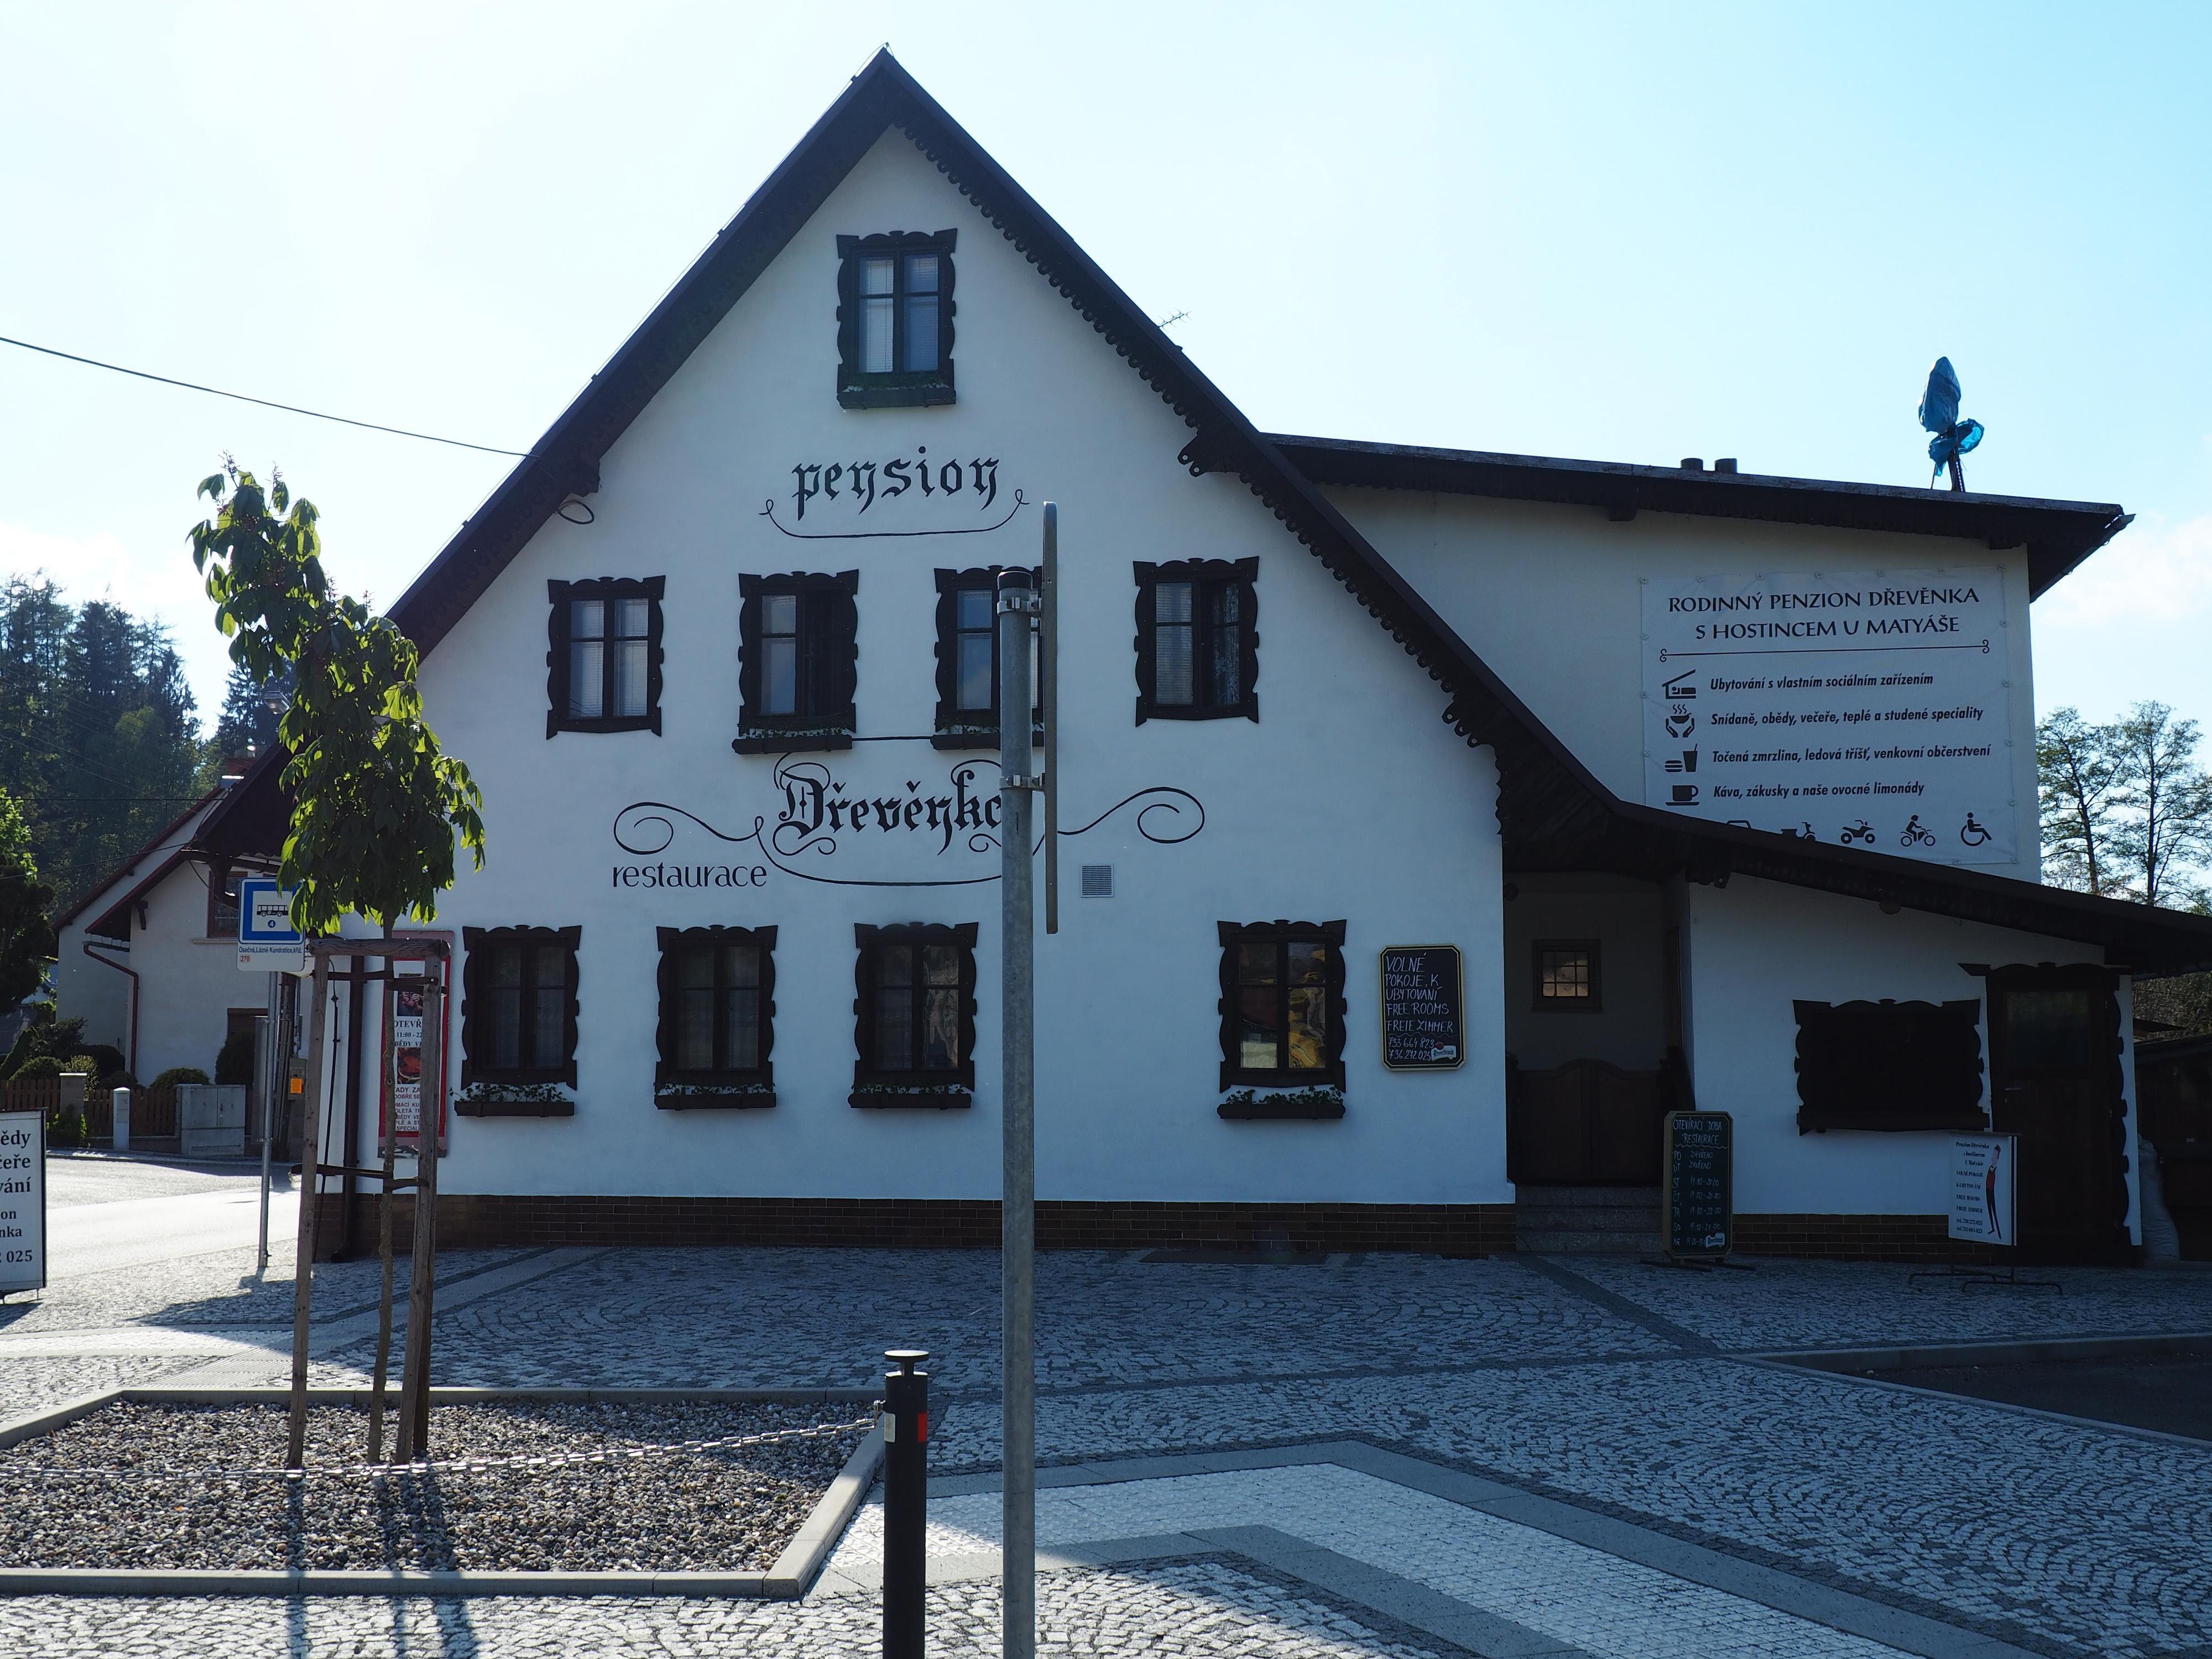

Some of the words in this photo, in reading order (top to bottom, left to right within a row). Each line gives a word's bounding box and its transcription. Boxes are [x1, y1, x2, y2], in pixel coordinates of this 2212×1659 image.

[791, 446, 1000, 521] pension
[1669, 592, 1763, 612] RODINNÝ
[1770, 592, 1860, 609] PENZION
[1869, 587, 1979, 606] DŘEVĚNKA
[1696, 624, 1705, 639] S
[1713, 620, 1837, 639] HOSTINCEM
[1844, 620, 1859, 635] U
[1867, 614, 1959, 634] MATYÁŠE
[1710, 677, 1766, 692] Ubytování
[1777, 676, 1822, 688] vlastním
[1826, 674, 1876, 686] sociálním
[1880, 673, 1933, 686] zařízením
[1711, 712, 1758, 726] Snídaně,
[1762, 712, 1797, 726] obědy,
[1801, 711, 1839, 724] večeře,
[1843, 709, 1871, 724] teplé
[1875, 712, 1881, 721] a
[1885, 708, 1928, 721] studené
[1932, 706, 1983, 722] speciality
[1713, 750, 1749, 763] Točená
[1752, 749, 1802, 763] zmrzlina,
[1805, 748, 1841, 760] ledová
[1845, 747, 1871, 761] tříšť,
[1874, 745, 1925, 759] venkovní
[1927, 744, 1991, 757] občerstvení
[1713, 785, 1743, 800] Káva,
[1746, 784, 1790, 799] zákusky
[1792, 787, 1799, 796] a
[1803, 784, 1828, 795] naše
[1832, 782, 1870, 795] ovocné
[1874, 781, 1924, 796] limonády
[613, 862, 767, 888] restaurace
[1386, 952, 1427, 972] VOLNÉ
[1431, 974, 1439, 987] K
[1386, 1003, 1410, 1016] FREE
[1411, 1002, 1449, 1015] ROOMS
[394, 1019, 421, 1027] OTEVŘ
[1403, 1037, 1418, 1048] 664
[1421, 1037, 1434, 1048] 823
[1389, 1050, 1403, 1060] 736
[1418, 1050, 1431, 1061] 025
[1673, 1117, 1704, 1130] OTEVÍRACÍ
[1708, 1120, 1722, 1131] DOBA
[0, 1130, 31, 1149] ědy
[1682, 1133, 1719, 1145] RESTAURACE
[0, 1154, 30, 1169] eře
[1673, 1150, 1681, 1160] PO
[1672, 1177, 1681, 1189] ST
[0, 1226, 22, 1238] nka
[7, 1250, 33, 1262] 025
